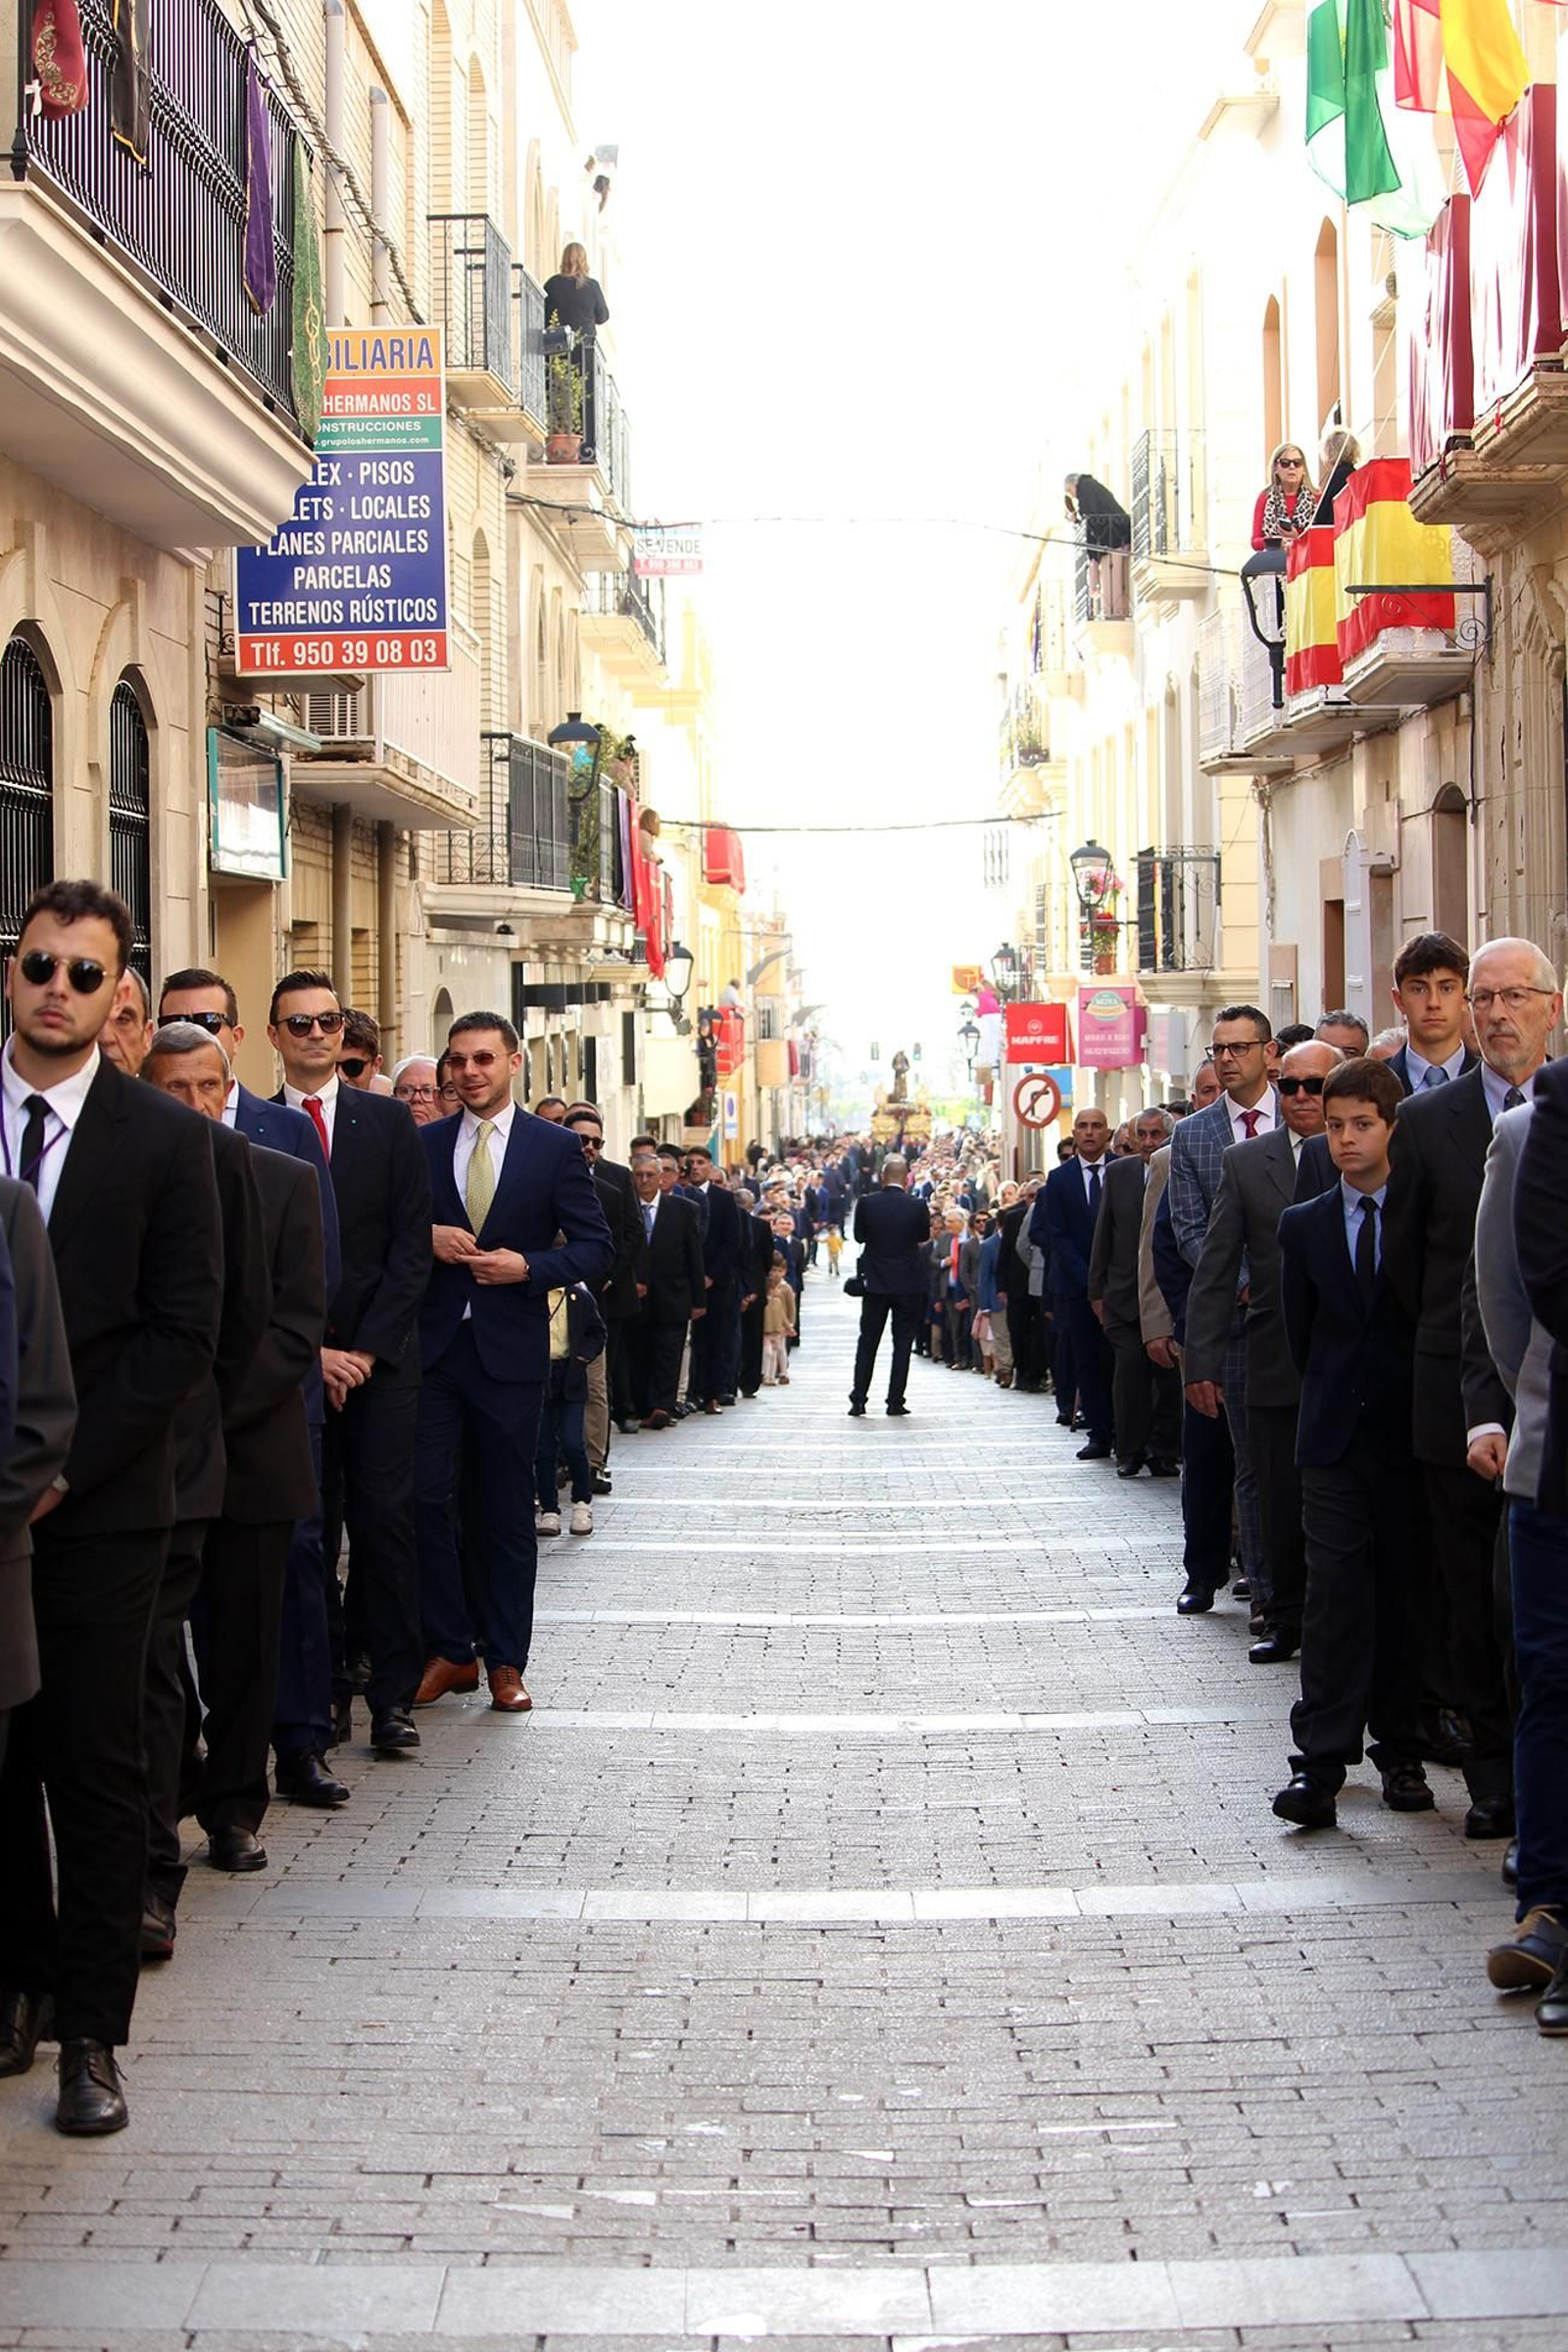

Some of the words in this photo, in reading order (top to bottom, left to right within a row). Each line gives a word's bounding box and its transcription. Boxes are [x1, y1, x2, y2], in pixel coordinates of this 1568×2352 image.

[323, 394, 411, 413] HERMANOS
[416, 393, 436, 412] SL
[360, 461, 415, 485] PISOS
[351, 495, 430, 519] LOCALES
[331, 529, 428, 555] PARCIALES
[656, 539, 701, 554] VENDE
[293, 564, 391, 590] PARCELAS
[248, 600, 343, 625] TERRENOS
[350, 594, 437, 623] RÚSTICOS
[250, 642, 286, 666] Tlf.
[294, 641, 333, 665] 950
[342, 640, 368, 664] 39
[376, 639, 402, 663] 08
[410, 638, 437, 663] 03
[1010, 1035, 1058, 1045] MAPFRE
